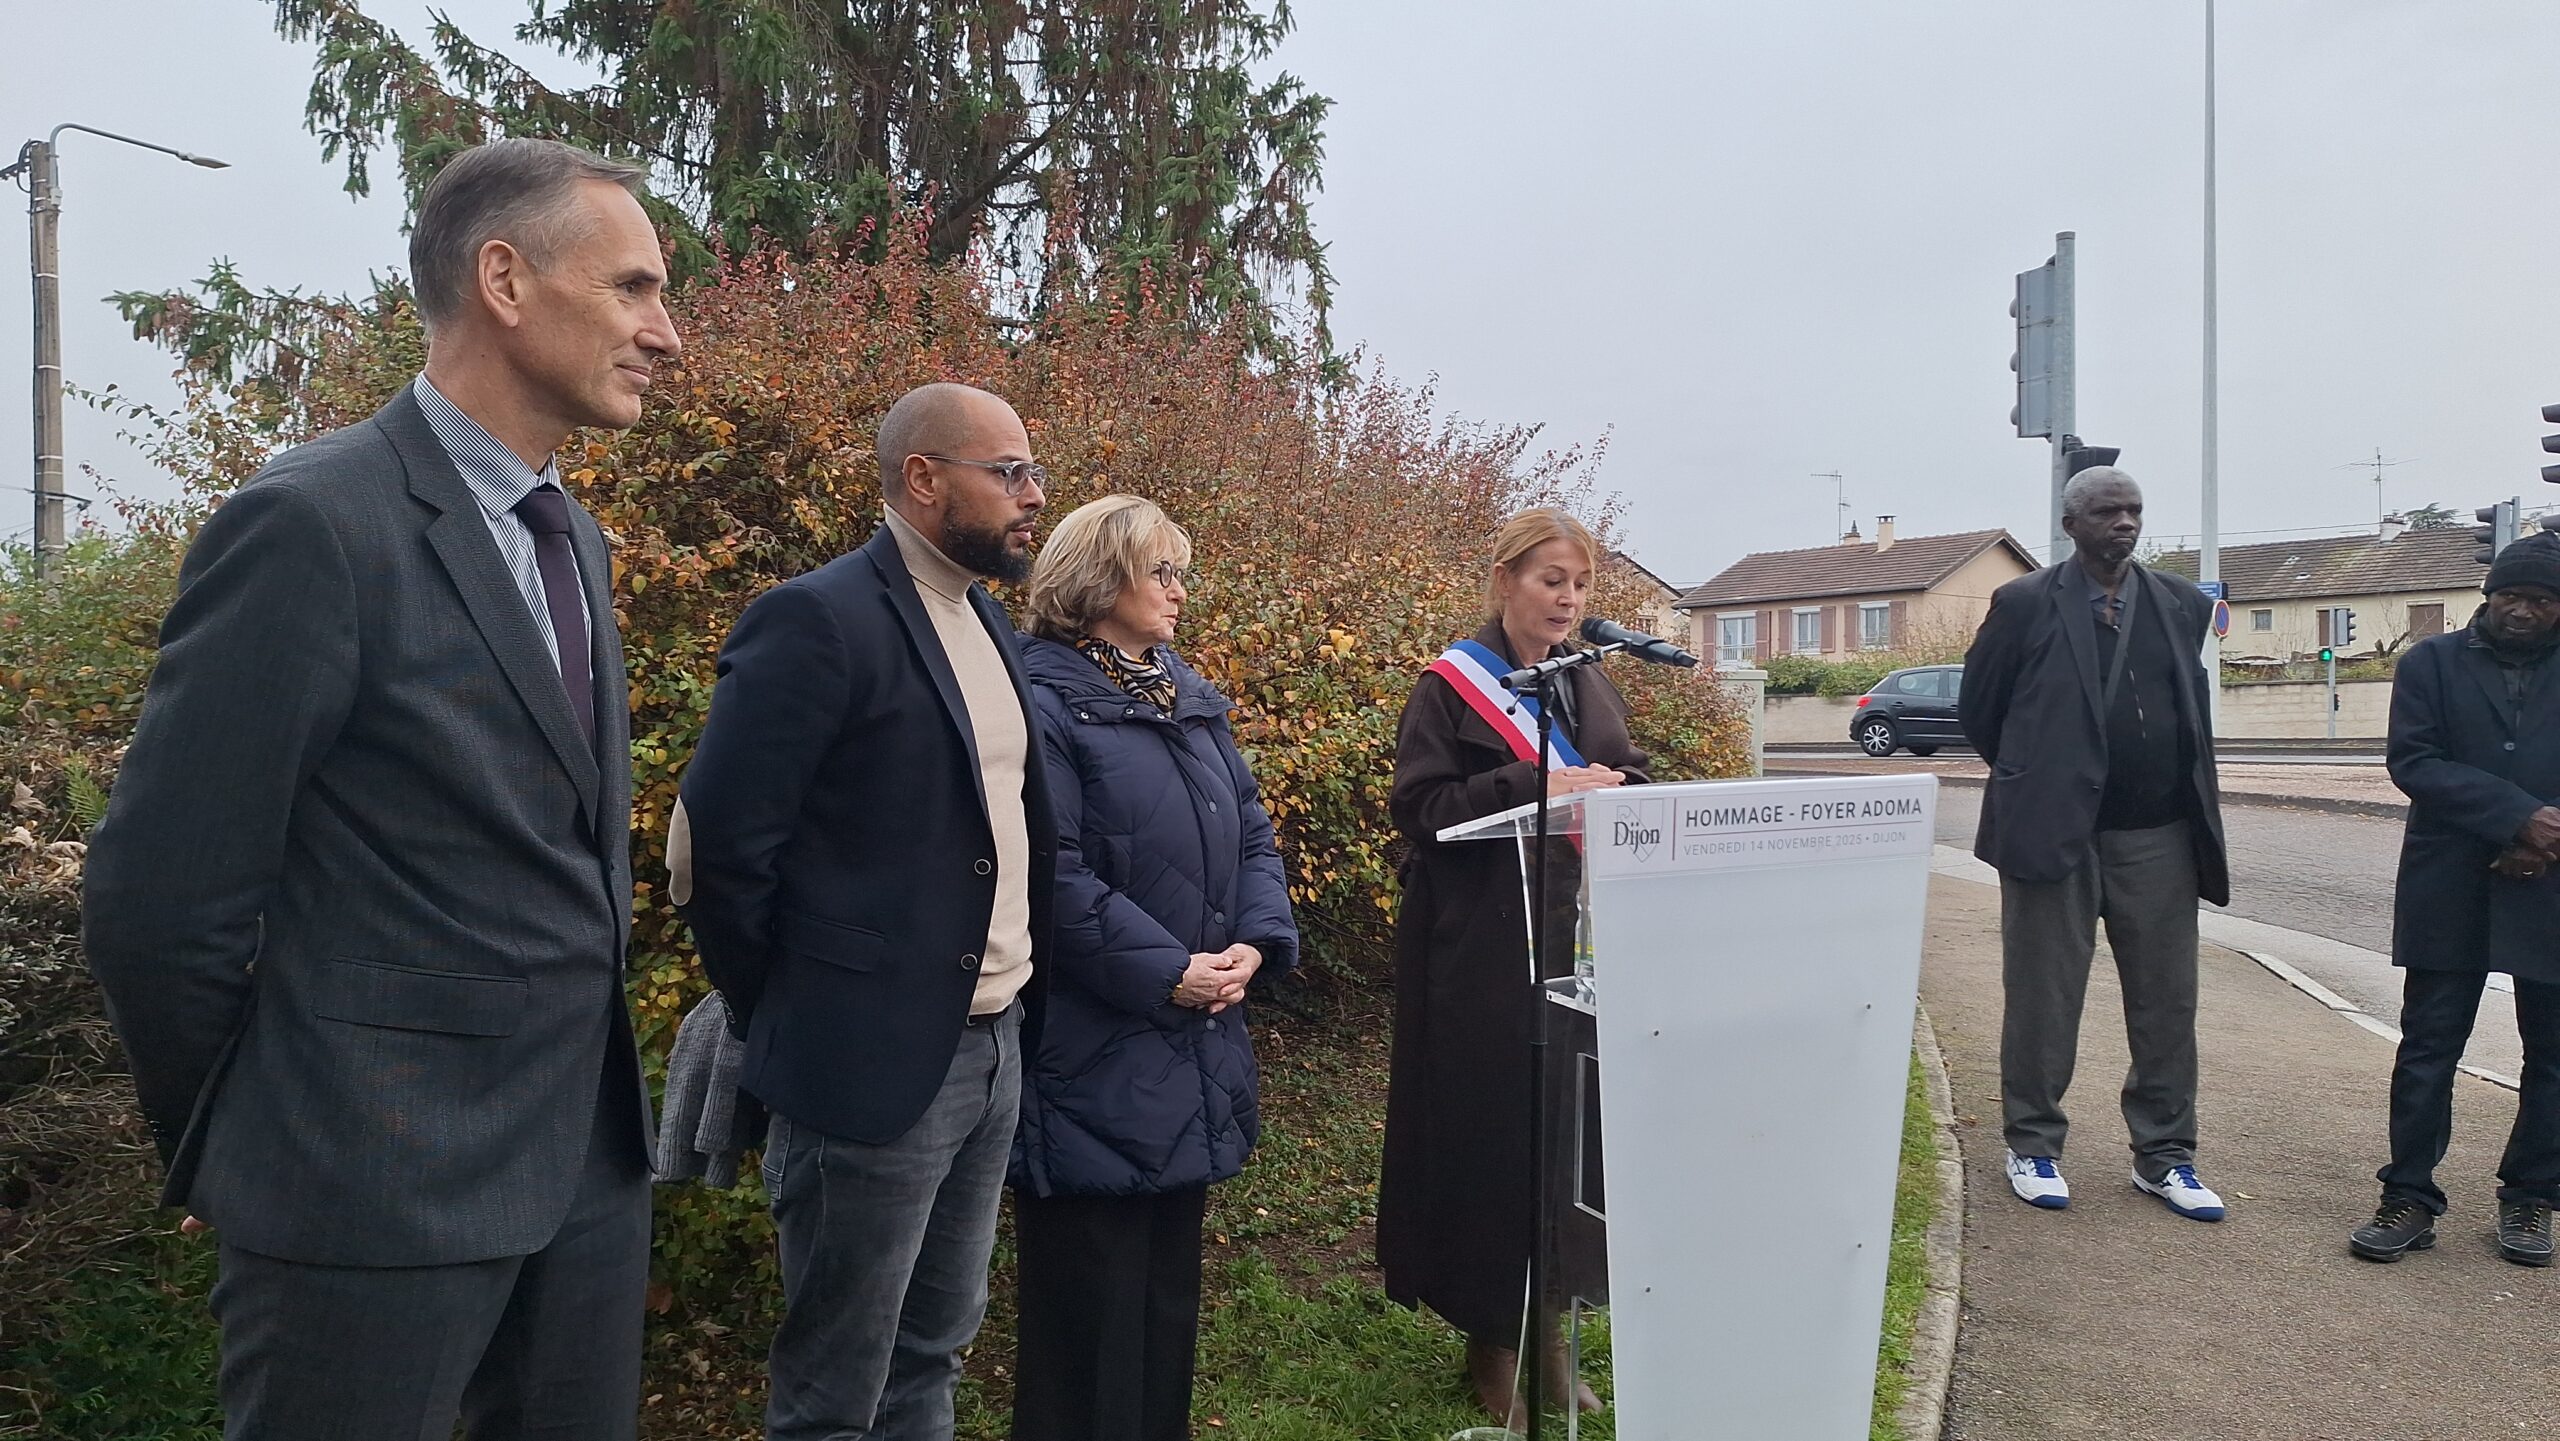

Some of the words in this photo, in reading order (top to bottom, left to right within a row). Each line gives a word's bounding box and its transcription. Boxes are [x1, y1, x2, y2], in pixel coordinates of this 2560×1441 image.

[1685, 805, 1784, 828] HOMMAGE
[1801, 802, 1856, 821] FOYER
[1861, 798, 1922, 818] ADOMA
[1612, 821, 1660, 854] Dijon
[1683, 841, 1745, 856] VENDREDI
[1751, 840, 1763, 852] 14
[1767, 835, 1831, 850] NOVEMBRE
[1836, 834, 1862, 847] 2025
[1872, 831, 1905, 844] DIJON
